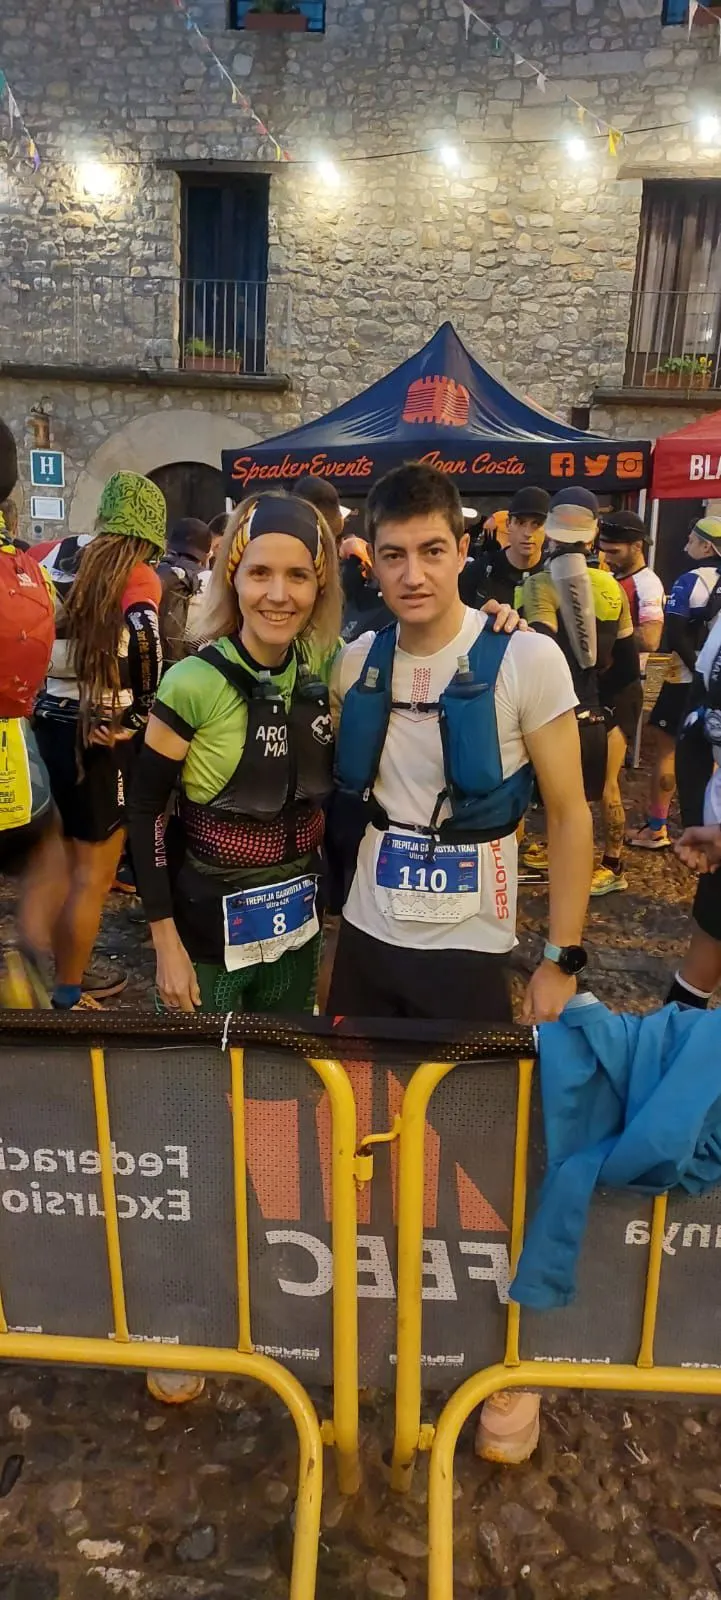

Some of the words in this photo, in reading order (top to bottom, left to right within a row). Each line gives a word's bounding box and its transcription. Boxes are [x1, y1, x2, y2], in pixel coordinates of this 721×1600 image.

[39, 456, 55, 476] H
[416, 450, 468, 475] Joan
[471, 453, 526, 476] Costa
[391, 839, 420, 851] TREPITJA
[420, 843, 456, 853] GAROTXA
[458, 843, 477, 853] TRAIL
[409, 852, 424, 861] Ultra
[398, 865, 448, 893] 110
[245, 892, 275, 907] TREPITJA
[266, 901, 280, 910] Ultra
[272, 912, 287, 936] 8
